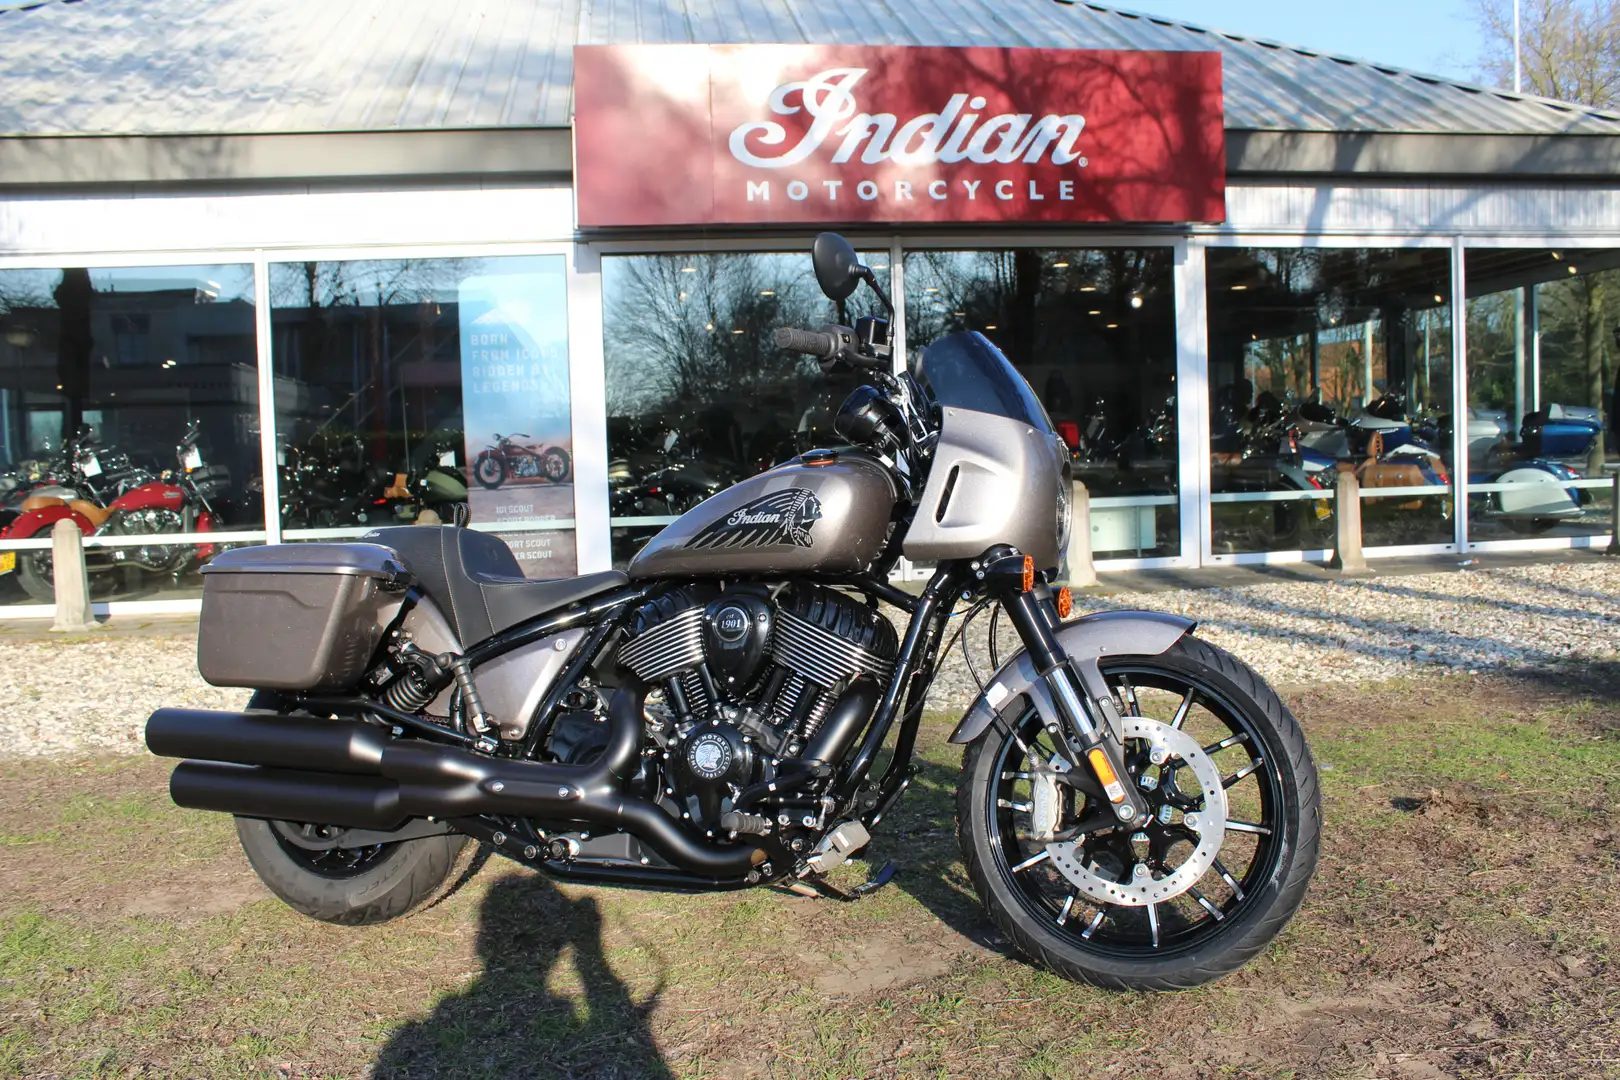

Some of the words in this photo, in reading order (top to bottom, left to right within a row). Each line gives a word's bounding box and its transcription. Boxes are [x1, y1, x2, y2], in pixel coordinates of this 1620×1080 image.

[729, 67, 1086, 168] Indian
[747, 180, 1075, 202] MOTORCYCLE
[470, 334, 508, 345] BORN
[472, 364, 524, 377] RIDDEN
[473, 380, 539, 394] LEGENDS
[508, 505, 534, 514] SCOUT
[727, 508, 781, 526] Indian
[507, 541, 524, 549] ORT
[525, 539, 551, 548] SCOUT
[526, 550, 552, 560] SCOUT
[721, 619, 741, 629] 1901
[690, 739, 701, 769] INDIAN
[701, 734, 730, 771] MOTORCYCLE
